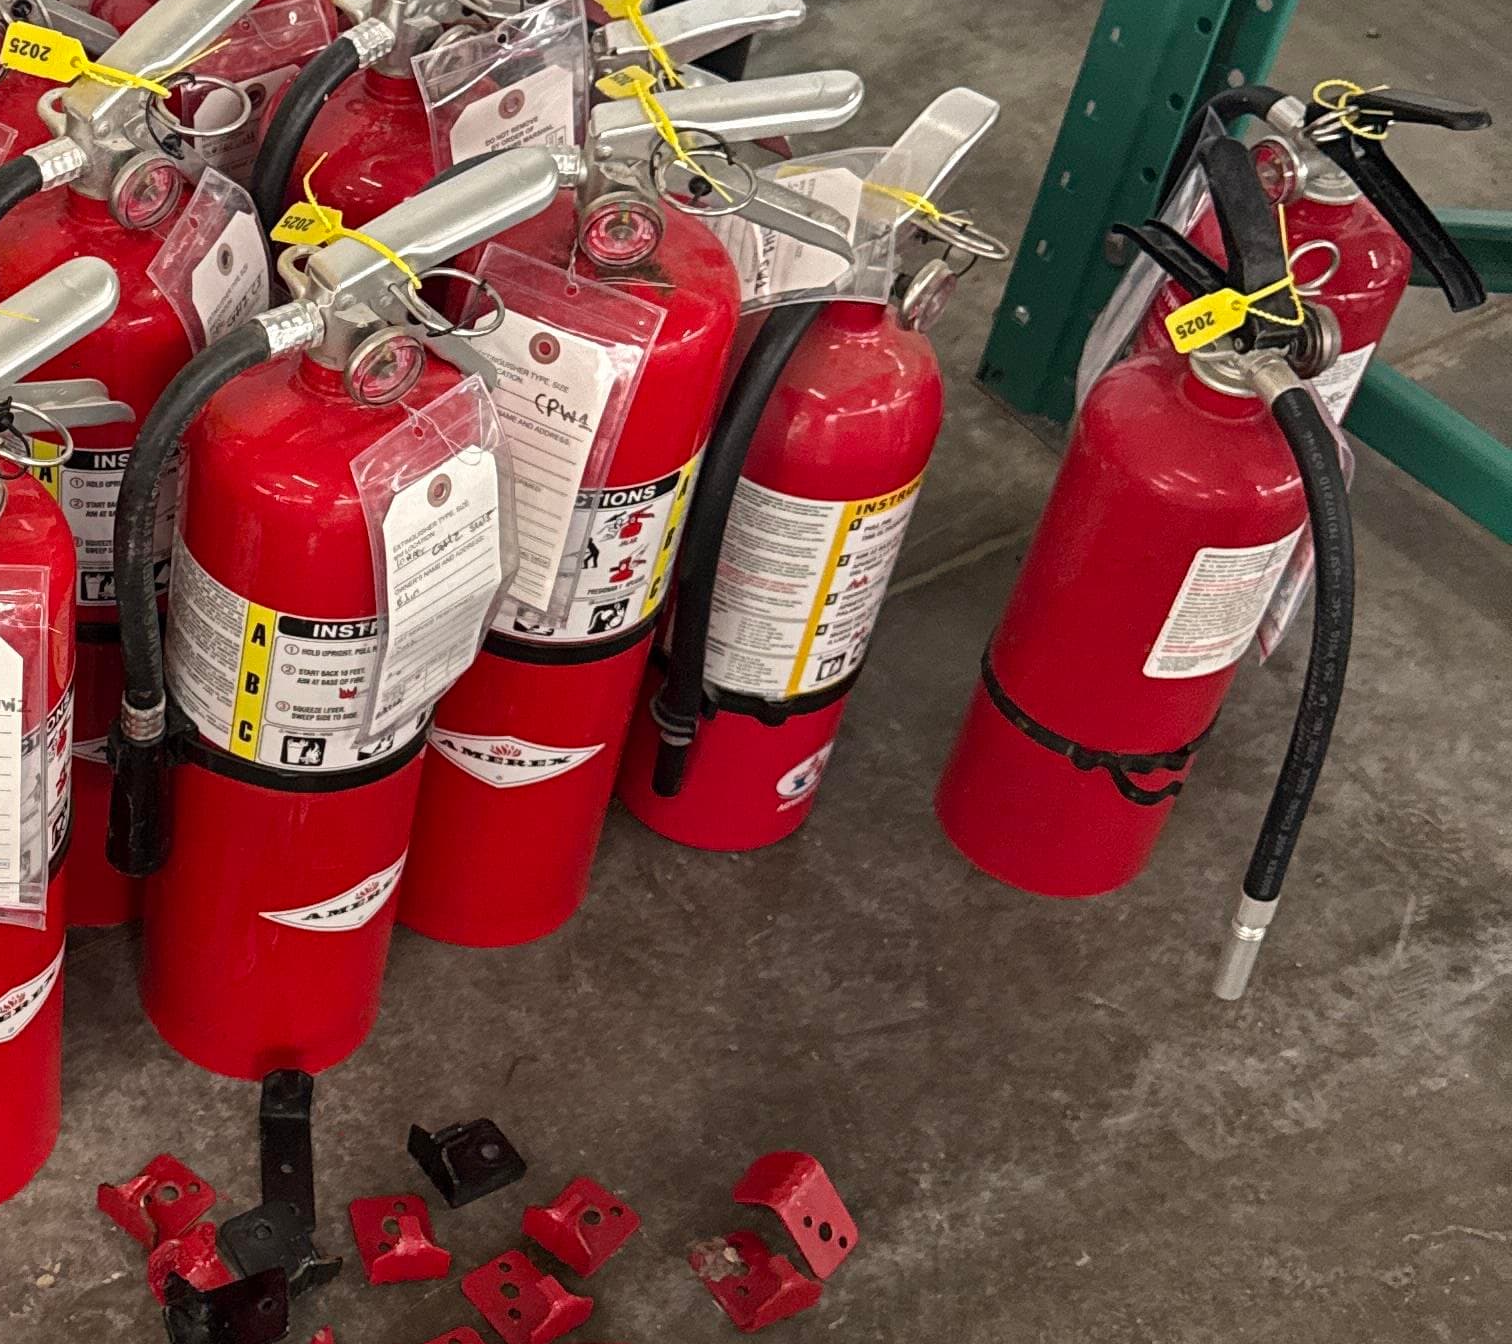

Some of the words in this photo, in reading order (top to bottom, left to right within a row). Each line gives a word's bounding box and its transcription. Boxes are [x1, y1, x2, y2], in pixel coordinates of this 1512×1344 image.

[9, 37, 51, 61] 2025
[281, 215, 315, 231] 2025
[1175, 311, 1216, 340] 2025
[251, 623, 266, 647] A
[245, 671, 260, 695] B
[238, 720, 254, 743] C
[437, 739, 573, 768] AMEREX
